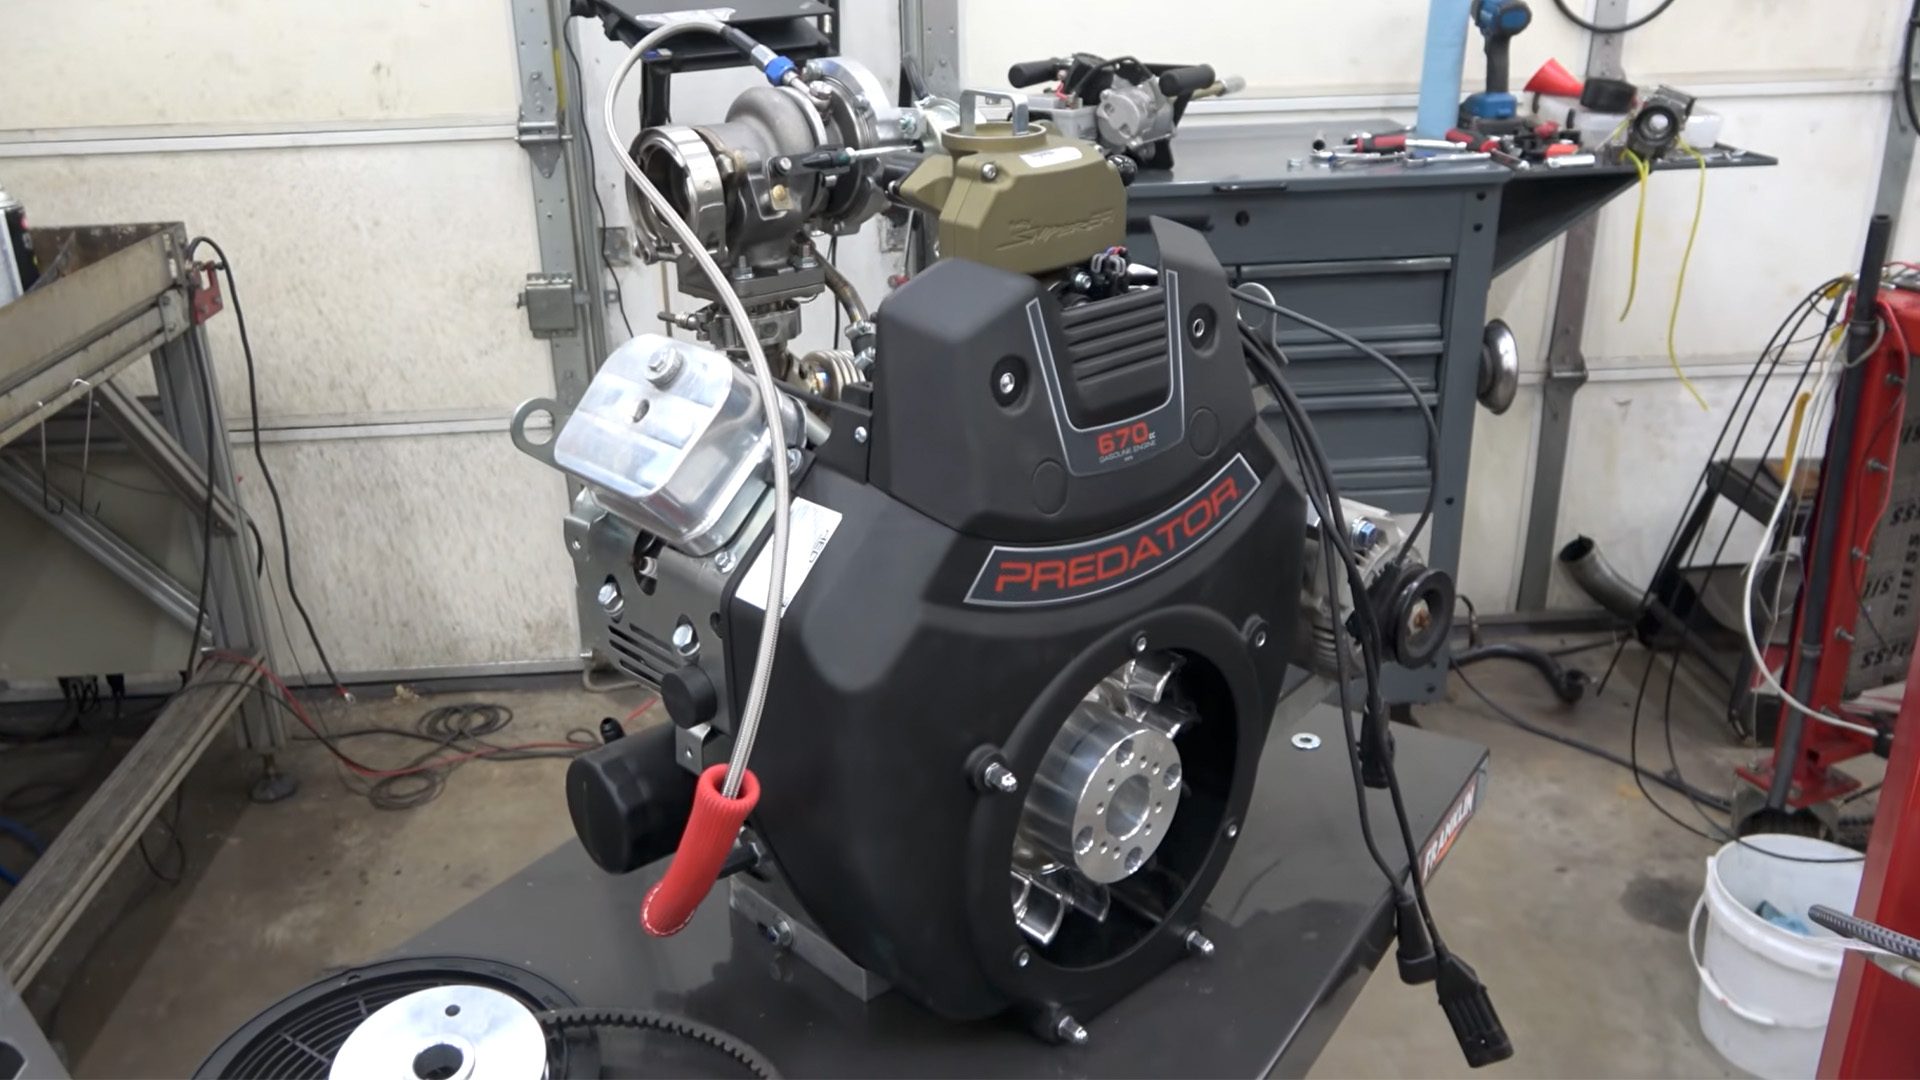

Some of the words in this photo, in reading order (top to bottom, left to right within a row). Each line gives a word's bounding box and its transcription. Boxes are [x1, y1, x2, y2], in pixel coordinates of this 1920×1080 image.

[1096, 421, 1149, 455] 670
[1099, 447, 1133, 464] GASOLINE
[1133, 439, 1156, 454] ENGINE
[994, 476, 1239, 593] PREDATOR
[1422, 784, 1476, 881] FRANKLIN
